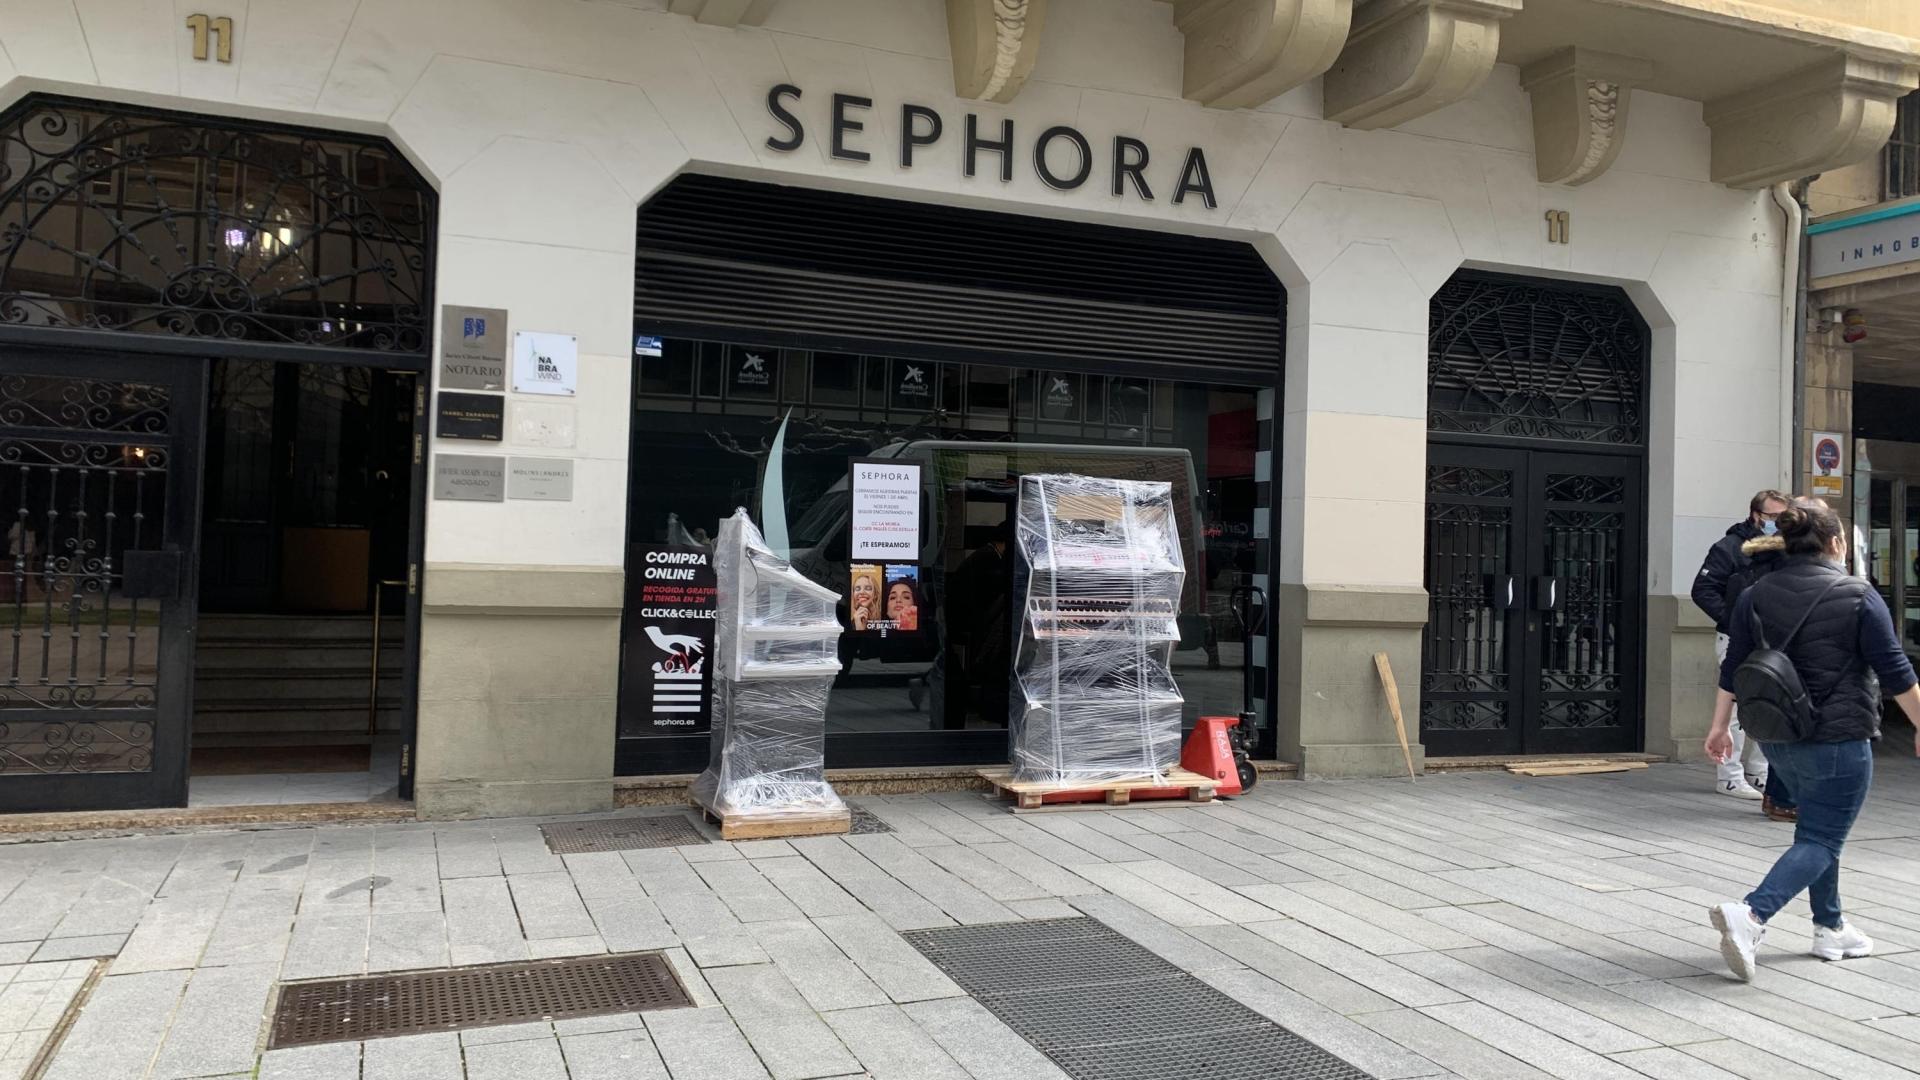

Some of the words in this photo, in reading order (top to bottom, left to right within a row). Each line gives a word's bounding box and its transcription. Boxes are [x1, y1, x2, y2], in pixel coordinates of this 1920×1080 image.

[186, 13, 232, 63] 11
[765, 83, 1218, 210] SEPHORA
[1544, 209, 1569, 244] 11
[1841, 236, 1920, 262] INMOB
[538, 356, 552, 364] NA
[445, 364, 502, 377] NOTARIO
[538, 364, 557, 373] BRA
[537, 372, 562, 381] WIND
[861, 471, 910, 481] SEPHORA
[450, 480, 490, 488] ABOGADO
[871, 541, 911, 549] ESPERAMOS!
[645, 551, 707, 566] COMPRA
[644, 567, 696, 581] ONLINE
[643, 586, 684, 595] RECOGIDA
[686, 587, 721, 596] GRATUIT
[655, 595, 682, 603] TIENDA
[641, 608, 717, 619] CLICK&COLLEC
[653, 718, 695, 728] sephora.es
[1216, 730, 1231, 759] RAJA
